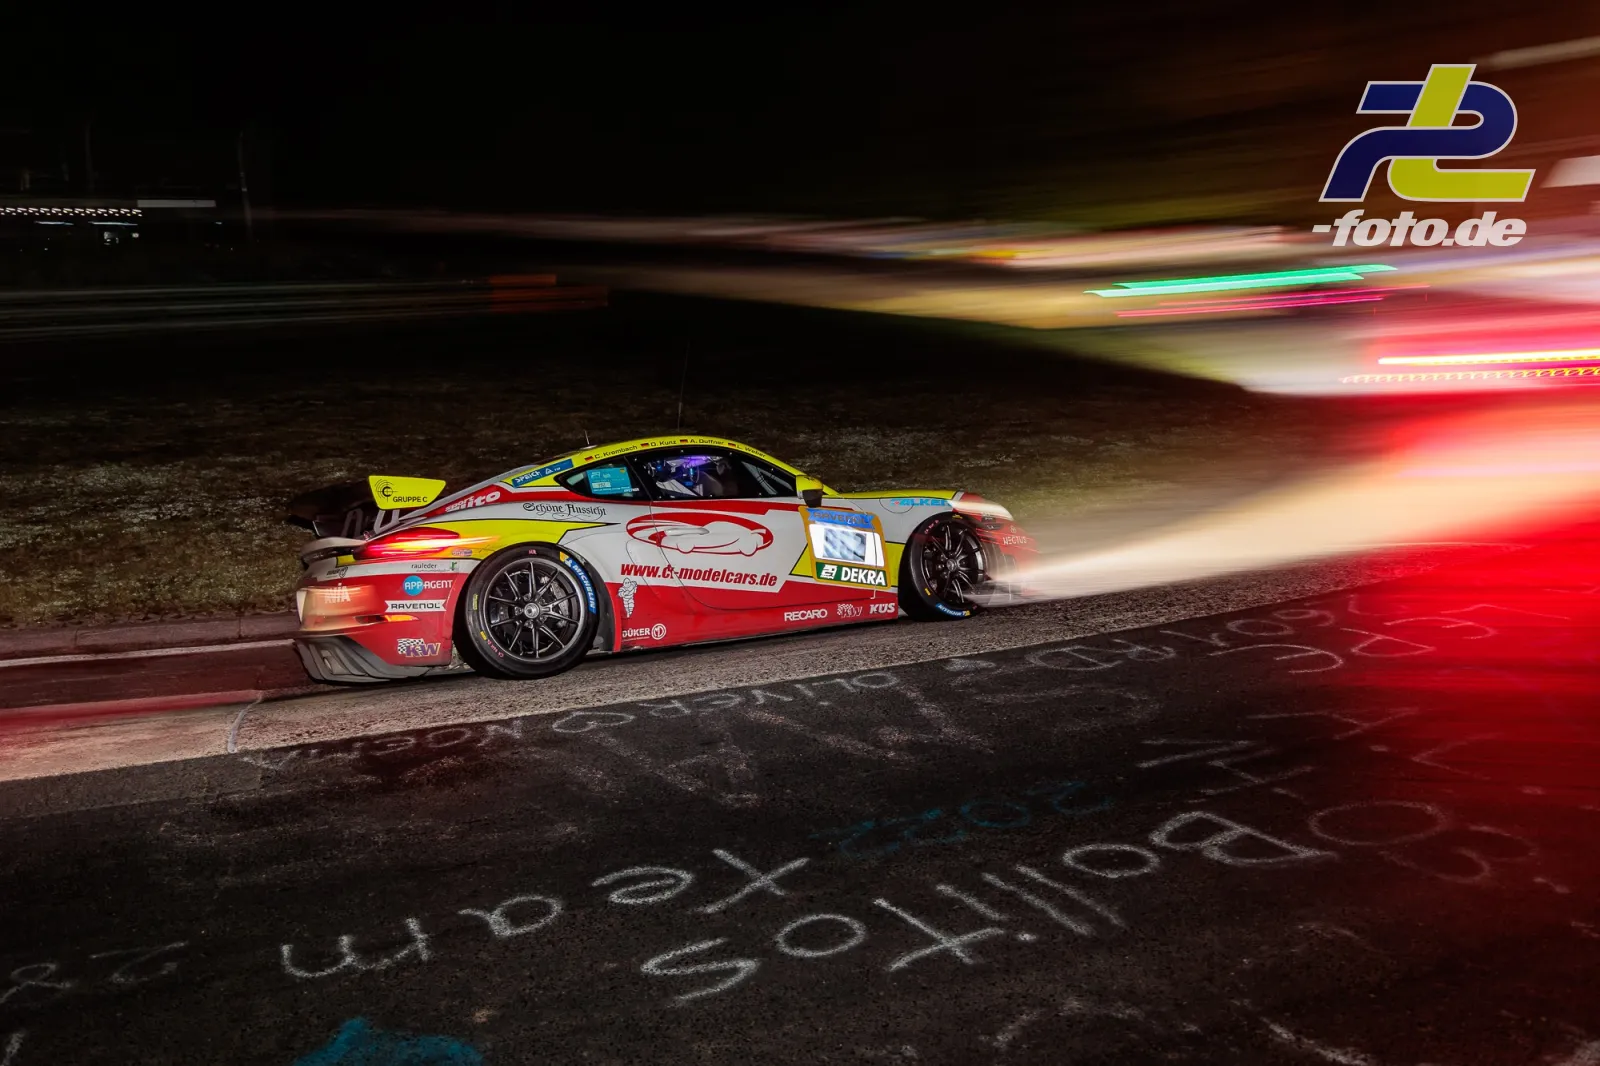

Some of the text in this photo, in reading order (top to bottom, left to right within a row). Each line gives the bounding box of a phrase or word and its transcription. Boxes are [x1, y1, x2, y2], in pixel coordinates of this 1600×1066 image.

[523, 502, 607, 518] Schöne Aussicht
[841, 566, 886, 586] DEKRA
[391, 602, 440, 610] RAVENOL
[783, 608, 828, 622] RECARO
[622, 628, 650, 638] DÜKER
[405, 642, 441, 658] KW
